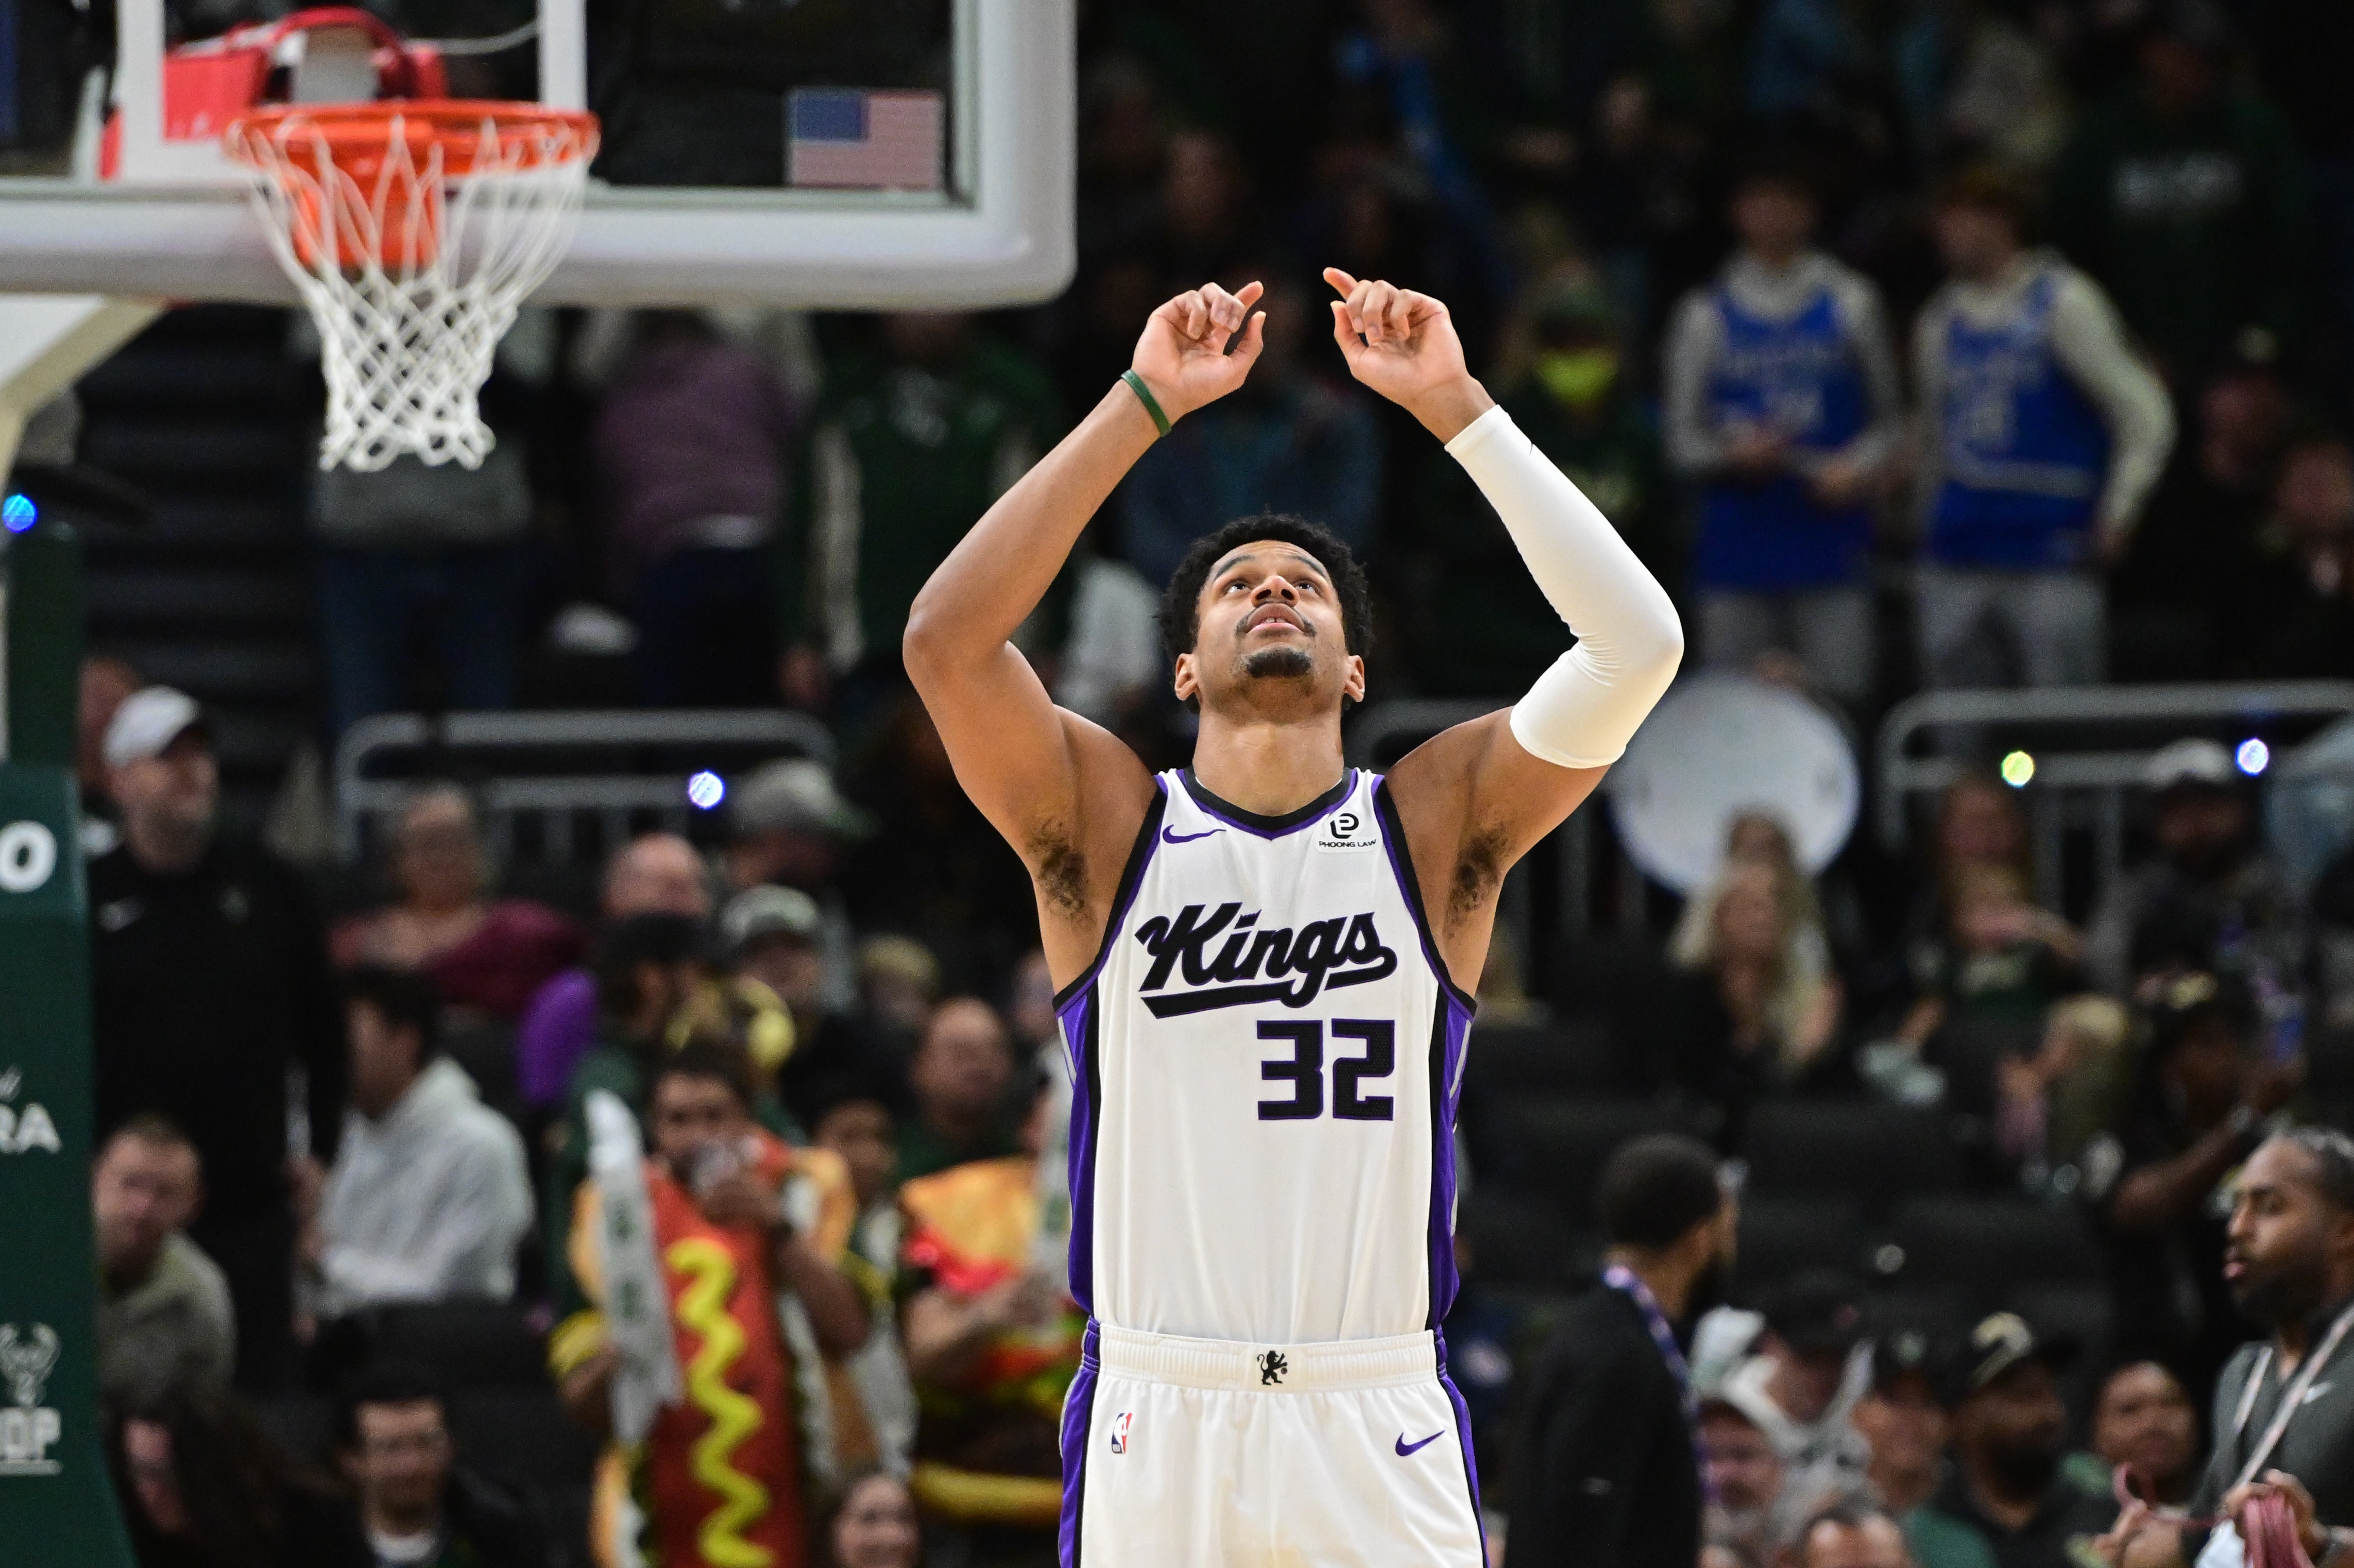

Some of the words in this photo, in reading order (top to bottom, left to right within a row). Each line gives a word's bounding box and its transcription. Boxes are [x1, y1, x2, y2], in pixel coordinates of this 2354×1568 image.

[1357, 839, 1376, 847] LAW
[1135, 902, 1397, 1019] Kings
[1257, 1019, 1395, 1120] 32
